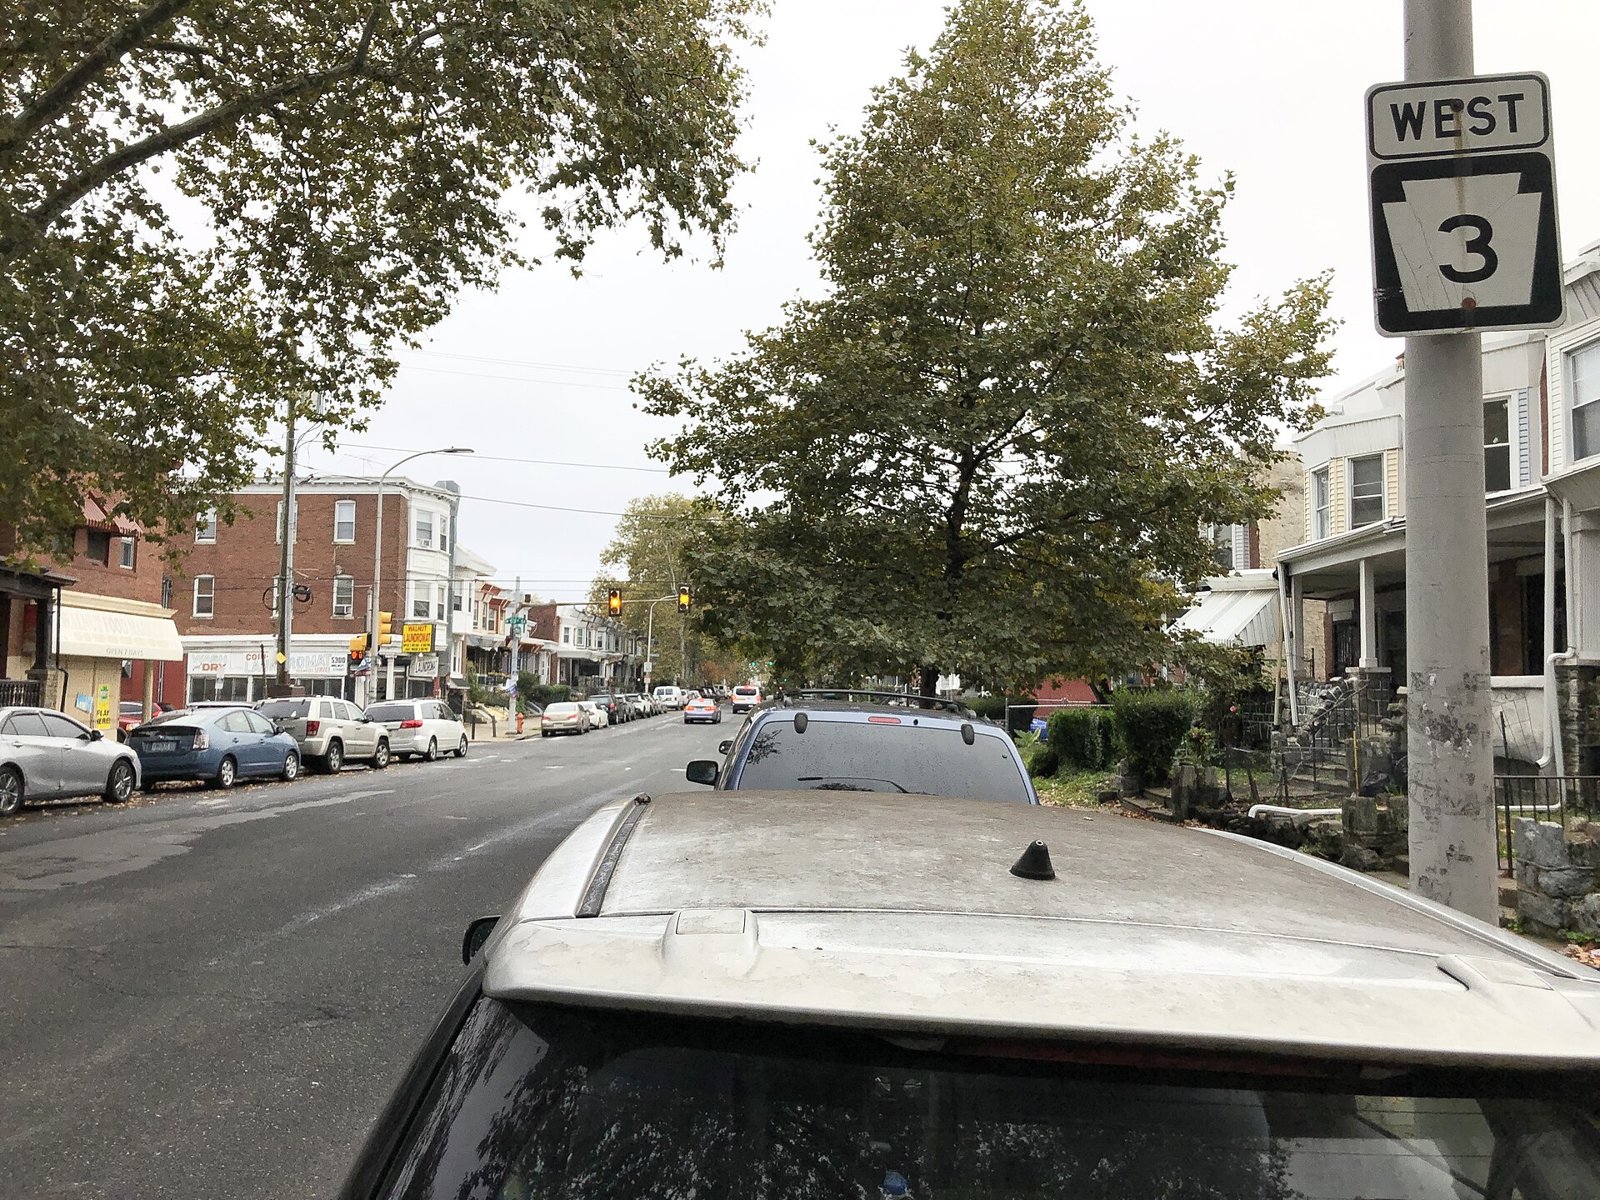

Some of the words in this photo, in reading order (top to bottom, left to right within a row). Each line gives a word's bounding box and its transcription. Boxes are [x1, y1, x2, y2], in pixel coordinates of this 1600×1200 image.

[1389, 93, 1525, 142] WEST
[1437, 213, 1499, 284] 3
[403, 632, 431, 643] LAUNDROMAT
[106, 647, 123, 656] OPEN
[128, 649, 144, 657] DAYS
[202, 663, 227, 671] DRY
